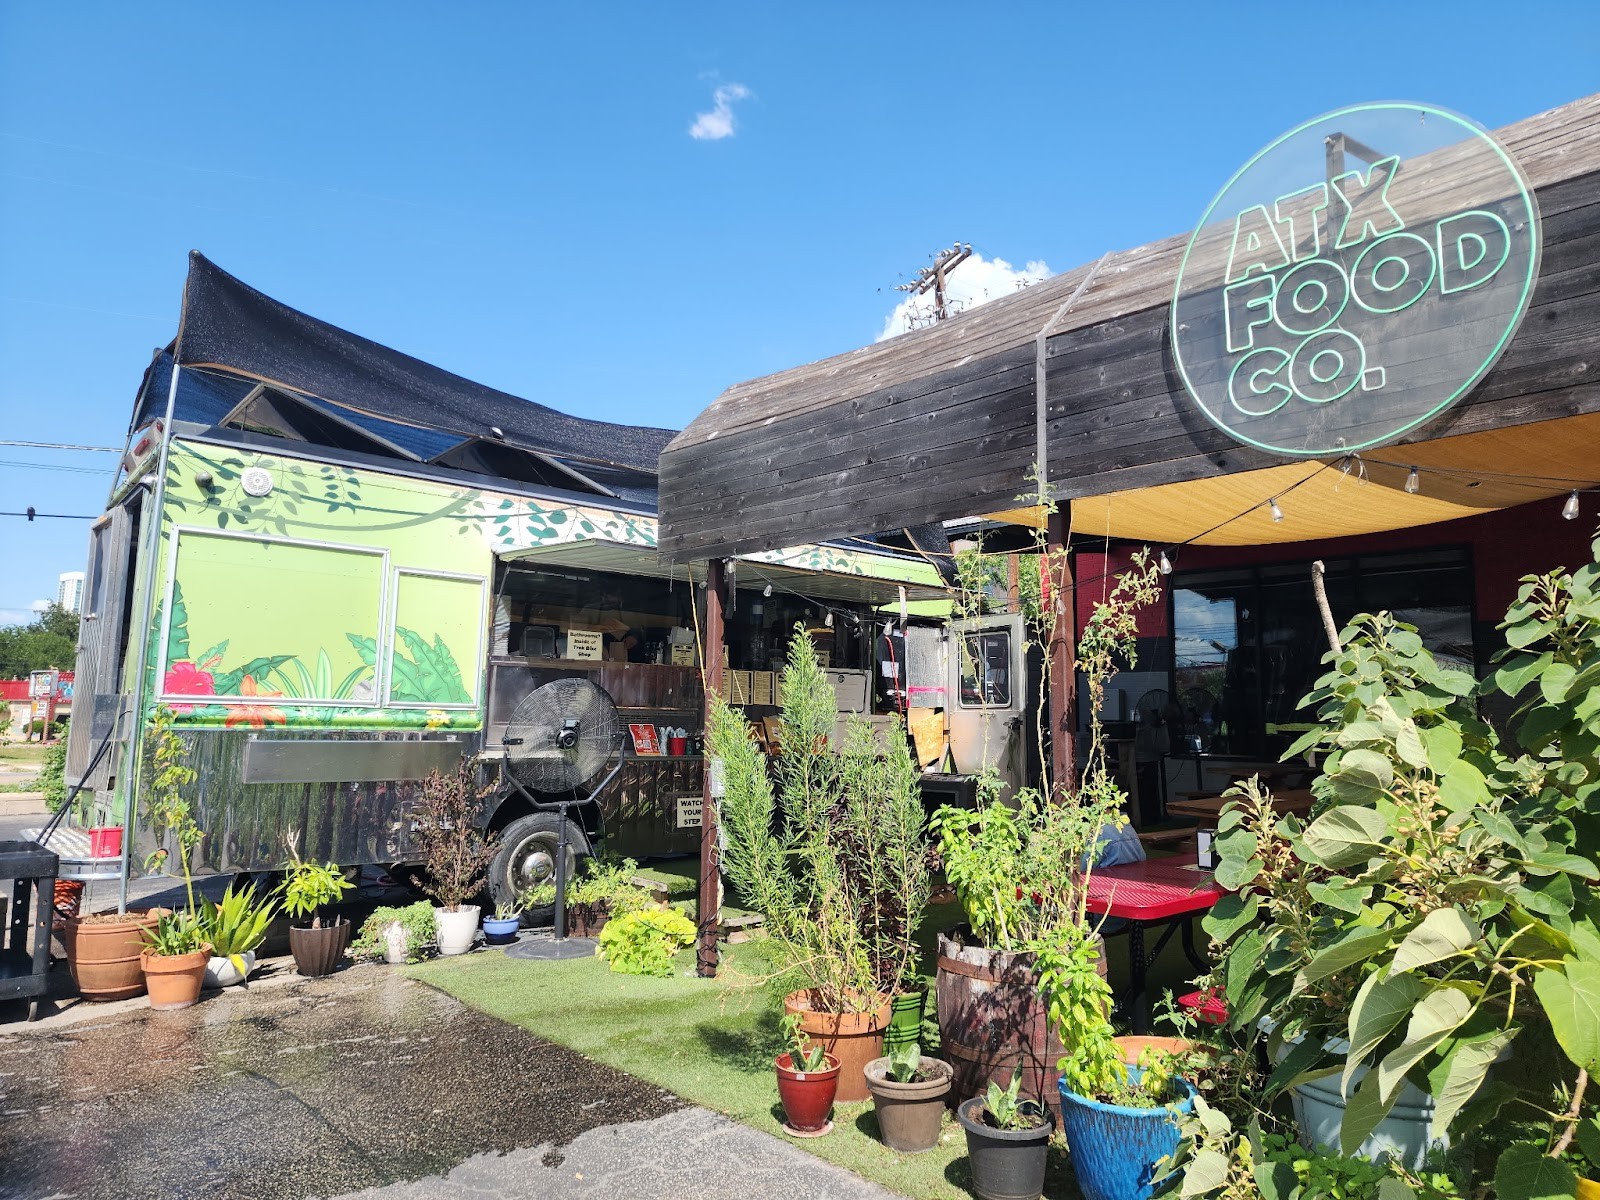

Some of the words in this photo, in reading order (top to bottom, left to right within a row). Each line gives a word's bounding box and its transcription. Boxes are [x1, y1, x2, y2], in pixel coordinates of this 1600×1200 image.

[1224, 210, 1511, 353] FOOD
[1225, 155, 1405, 284] ATX
[1228, 328, 1386, 416] CO.
